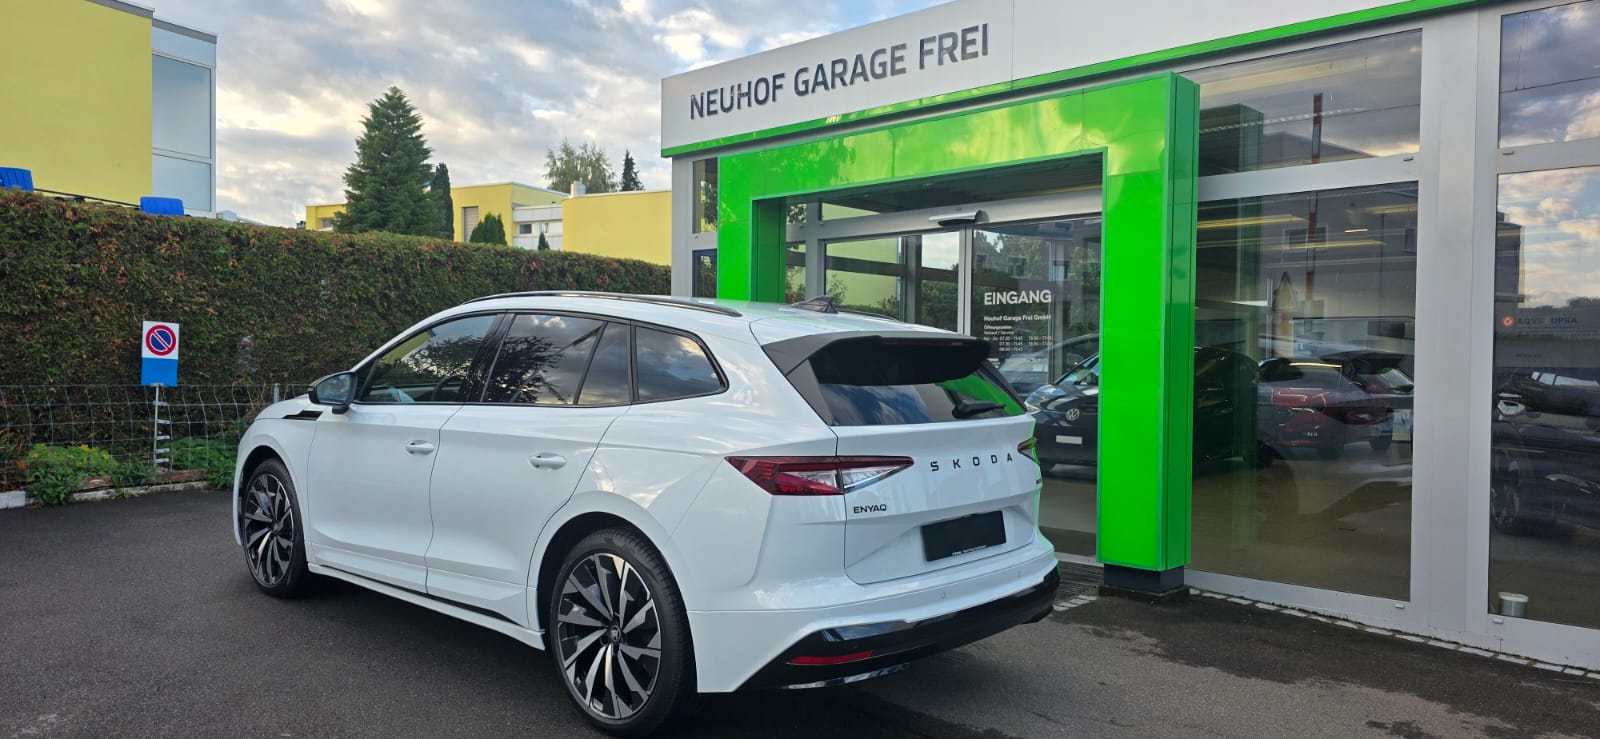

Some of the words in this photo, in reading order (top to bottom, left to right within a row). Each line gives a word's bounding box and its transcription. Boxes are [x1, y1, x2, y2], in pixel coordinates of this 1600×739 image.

[689, 73, 786, 120] NEUHOF
[793, 43, 907, 97] GARAGE
[919, 23, 989, 69] FREI
[984, 289, 1052, 305] EINGANG
[1551, 316, 1577, 324] UPSA
[930, 452, 1013, 471] SKODA
[853, 503, 887, 514] ENYAQ
